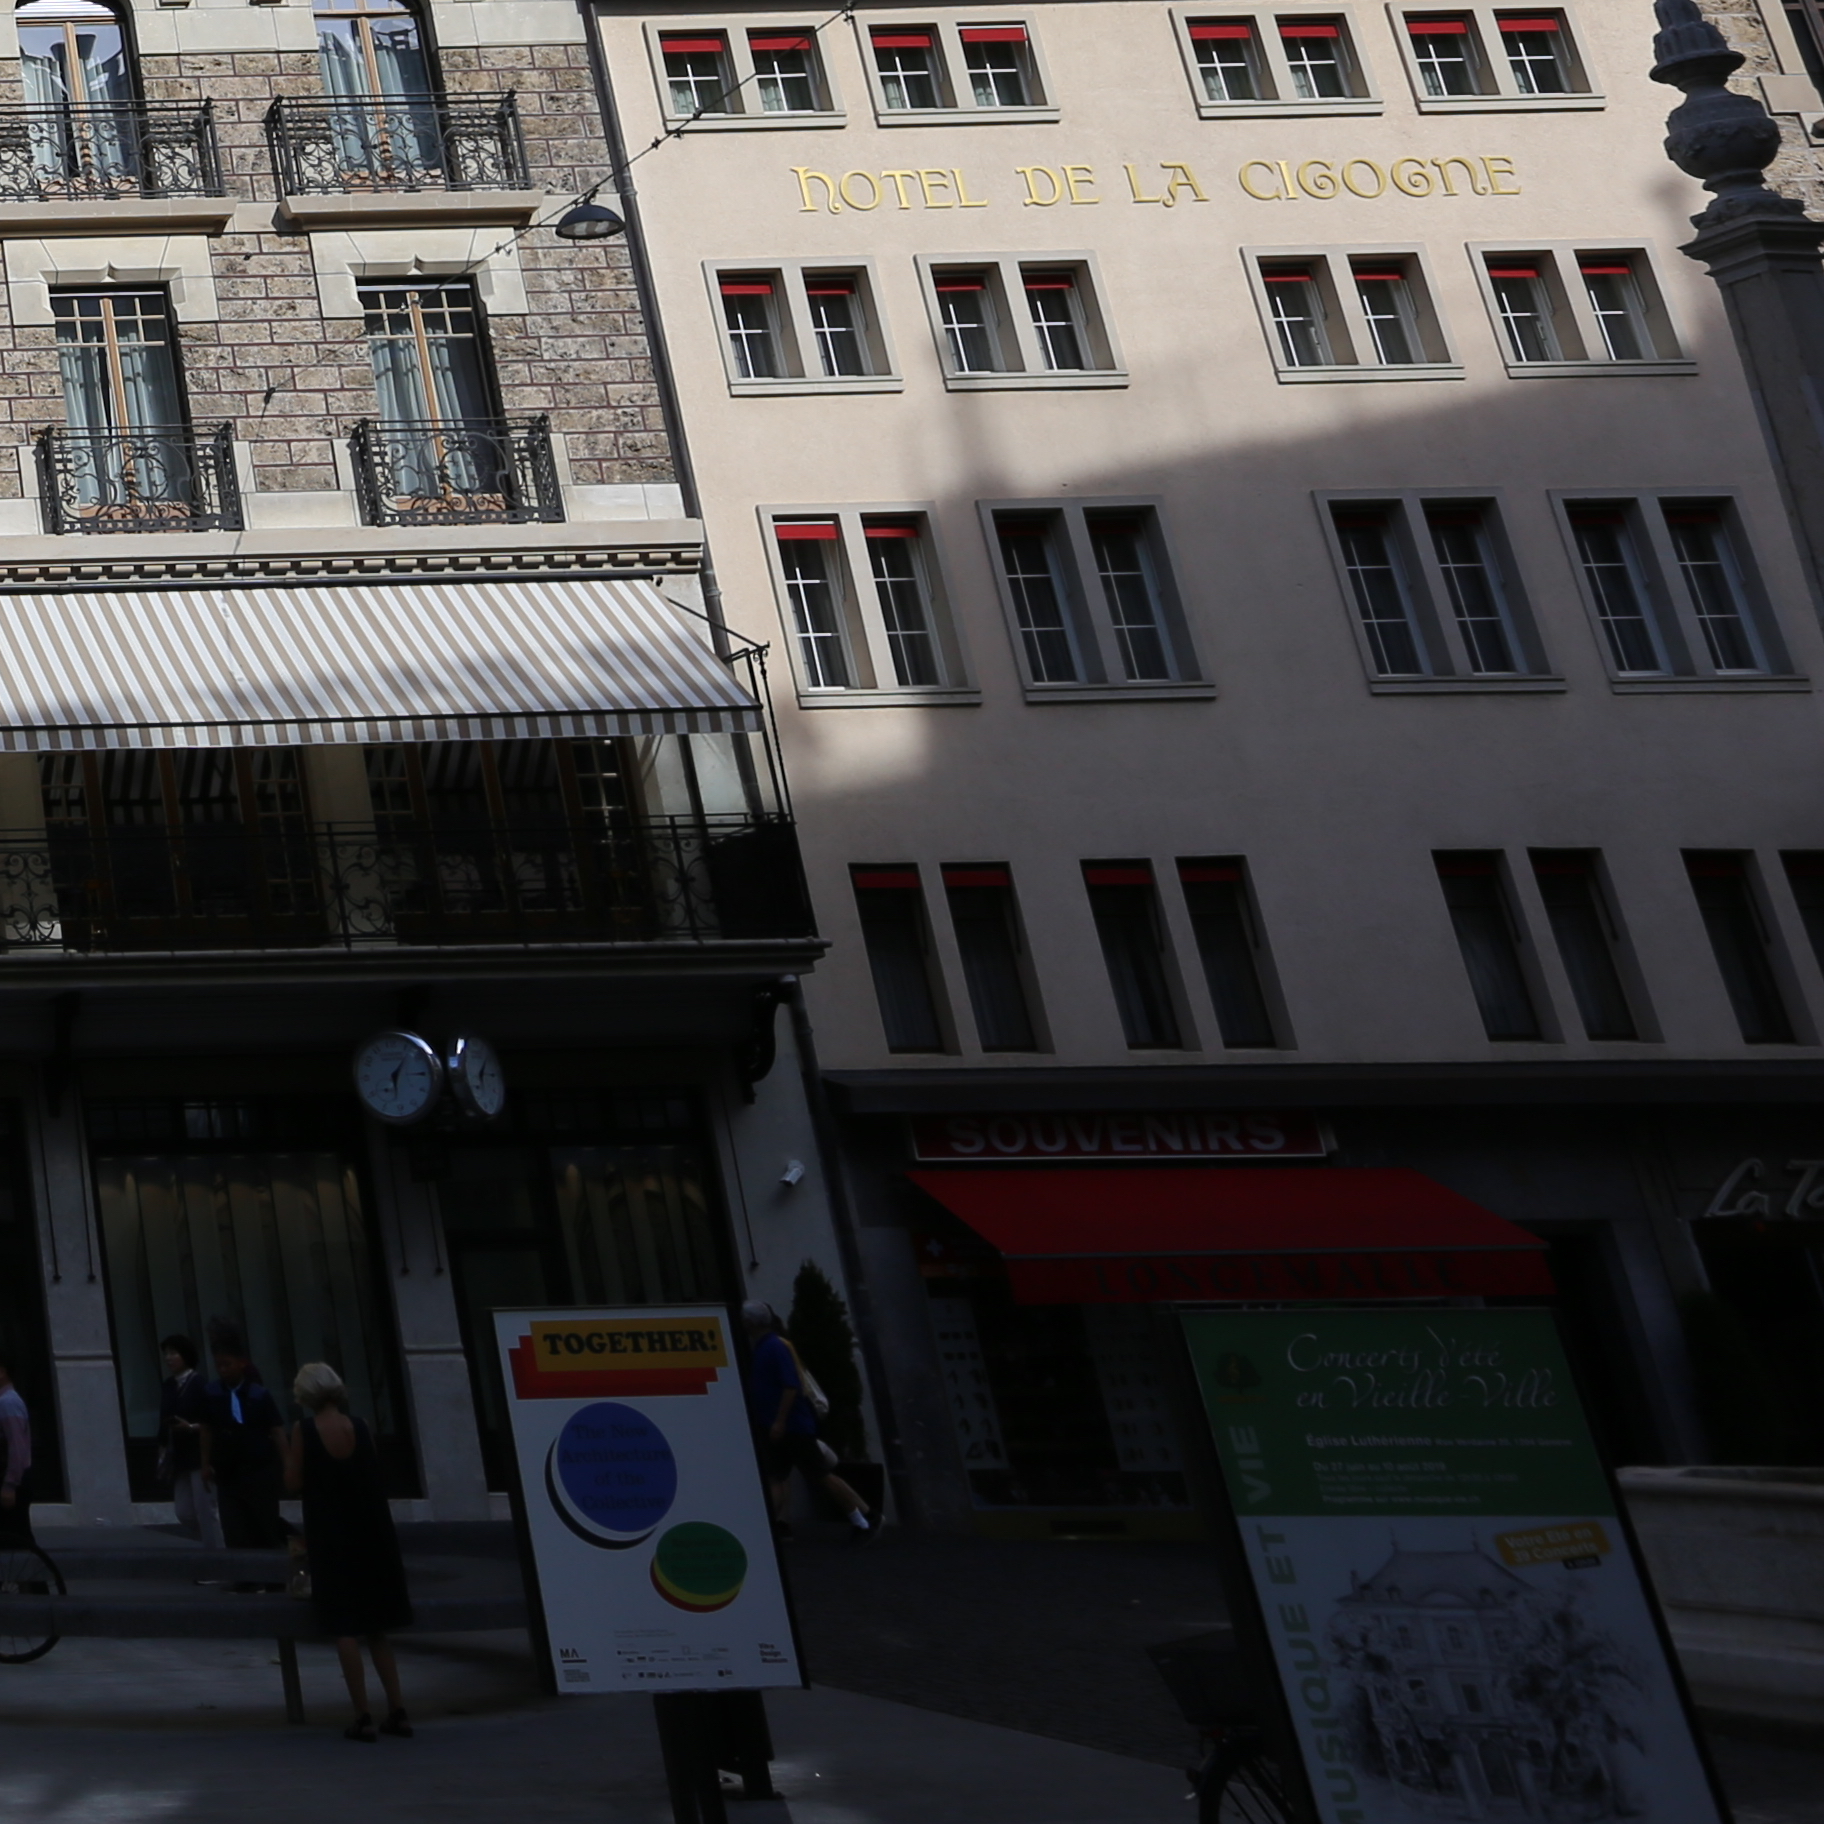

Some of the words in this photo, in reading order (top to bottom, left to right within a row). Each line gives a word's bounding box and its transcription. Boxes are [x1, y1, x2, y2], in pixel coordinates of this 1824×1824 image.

[792, 165, 989, 215] HOTEL
[1015, 163, 1101, 208] DE
[1122, 160, 1211, 209] LA
[1238, 155, 1523, 200] CIGOGNE
[949, 1114, 1287, 1154] SOUVENIRS
[1703, 1157, 1770, 1217] La
[1092, 1256, 1465, 1297] LONGEMALLE
[542, 1329, 719, 1355] TOGETHER!
[1287, 1332, 1423, 1373] Concerts
[1426, 1325, 1503, 1368] d'été
[1297, 1388, 1330, 1409] en
[571, 1424, 605, 1438] The
[610, 1424, 648, 1437] New
[1306, 1432, 1349, 1449] Église
[1352, 1434, 1433, 1447] Luthérienne
[562, 1448, 671, 1464] Architecture
[1228, 1425, 1272, 1505] VIE
[594, 1471, 611, 1485] of
[617, 1470, 645, 1485] the
[581, 1495, 666, 1510] Collective
[1256, 1524, 1297, 1585] ET
[1532, 1541, 1600, 1560] Concerts
